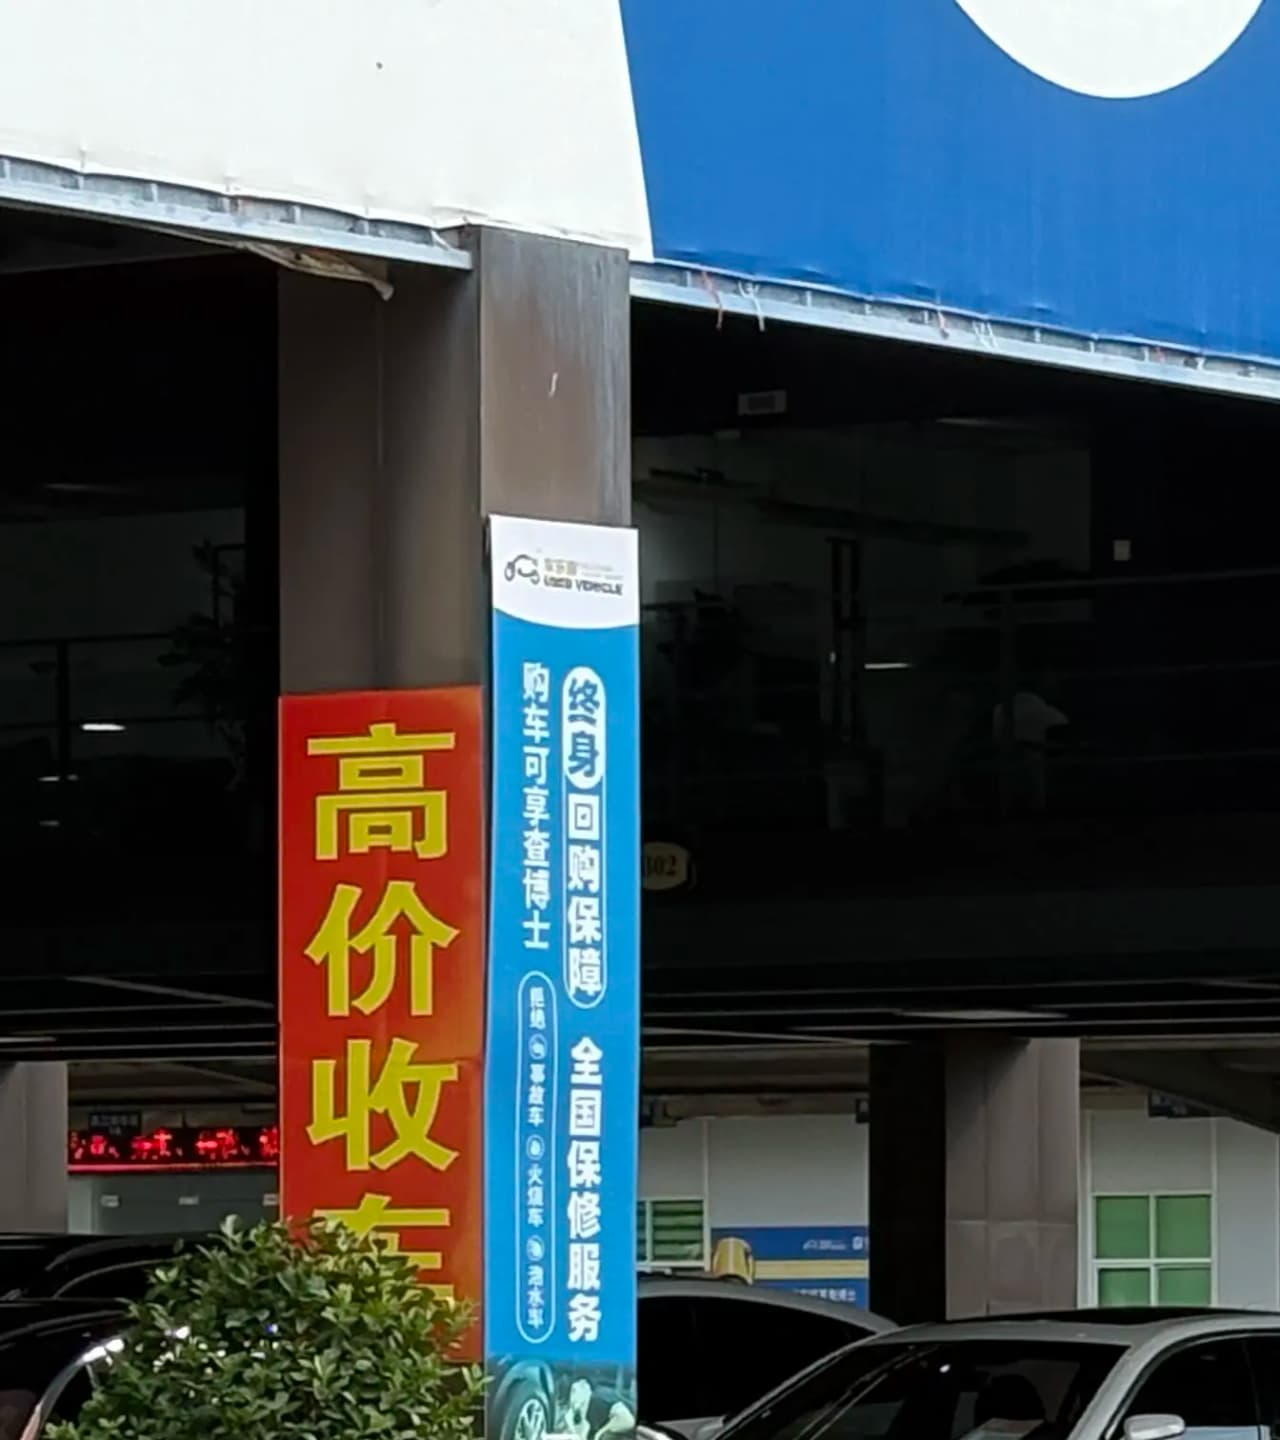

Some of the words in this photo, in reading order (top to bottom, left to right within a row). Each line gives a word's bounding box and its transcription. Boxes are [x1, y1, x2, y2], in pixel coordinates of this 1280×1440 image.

[522, 662, 550, 949] 购车可享查博士
[567, 679, 602, 996] 终身回购保障
[566, 1036, 603, 1342] 全国保修服务
